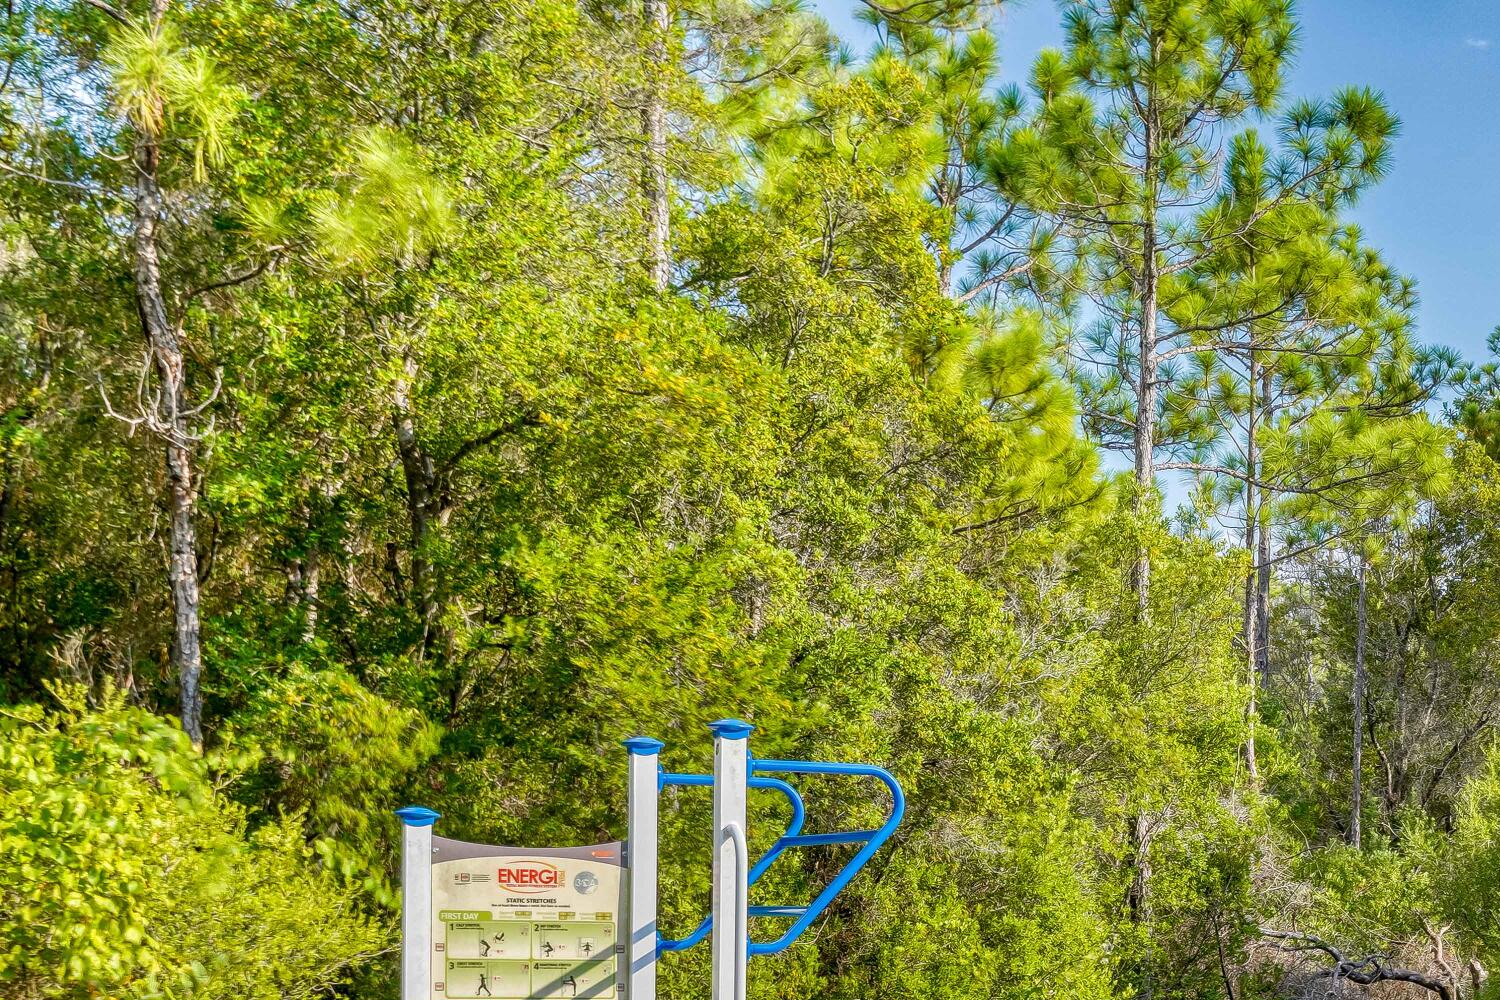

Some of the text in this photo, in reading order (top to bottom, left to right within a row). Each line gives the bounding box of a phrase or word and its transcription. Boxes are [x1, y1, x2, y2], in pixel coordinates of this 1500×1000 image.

[498, 868, 558, 884] ENERGI
[441, 912, 462, 920] FIRST
[449, 923, 454, 931] 1
